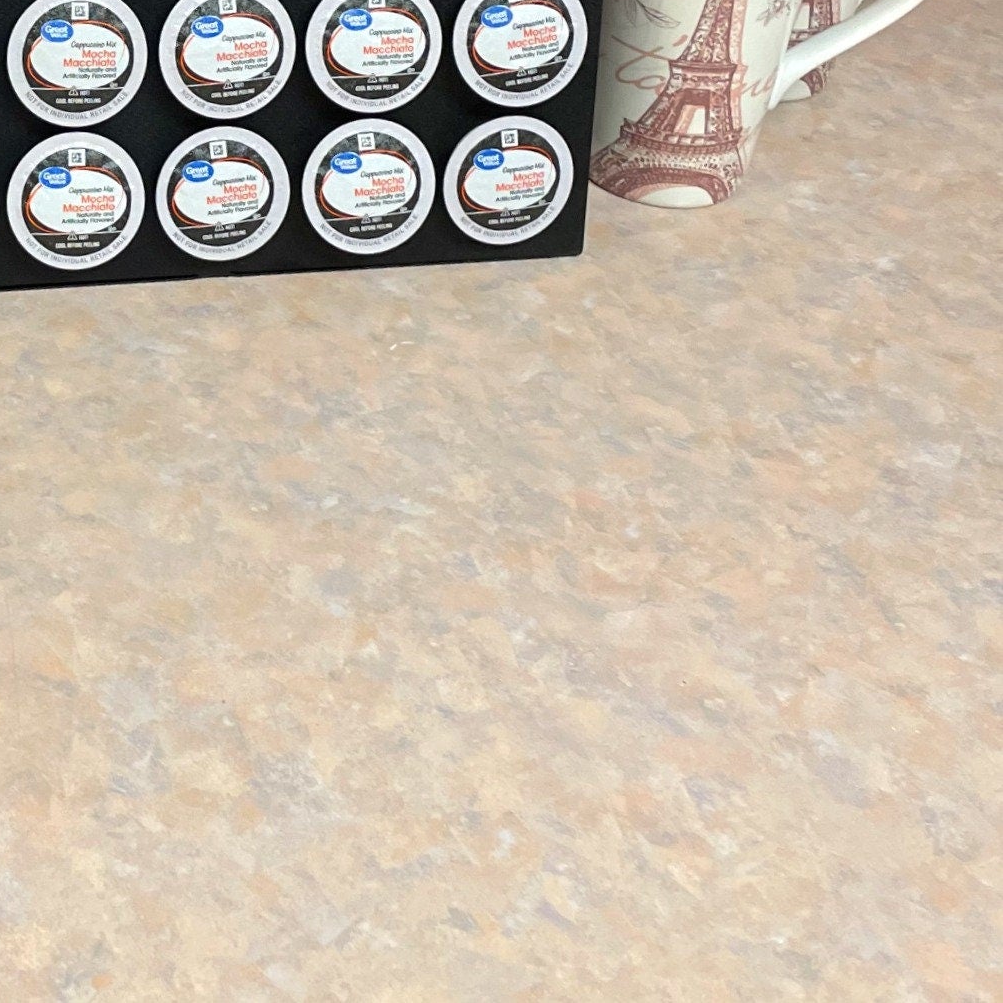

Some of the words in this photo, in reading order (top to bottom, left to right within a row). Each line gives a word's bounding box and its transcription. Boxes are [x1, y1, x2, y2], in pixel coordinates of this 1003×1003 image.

[234, 39, 267, 50] Mocha
[381, 36, 413, 44] Mocha
[216, 48, 267, 60] Macchiato
[363, 44, 413, 54] Macchiato
[64, 58, 116, 66] Macchiato
[372, 175, 404, 186] Mocha
[225, 182, 257, 193] Mocha
[355, 184, 404, 195] Macchiato
[81, 194, 114, 202] Mocha
[207, 191, 257, 203] Macchiato
[62, 203, 114, 211] Macchiato
